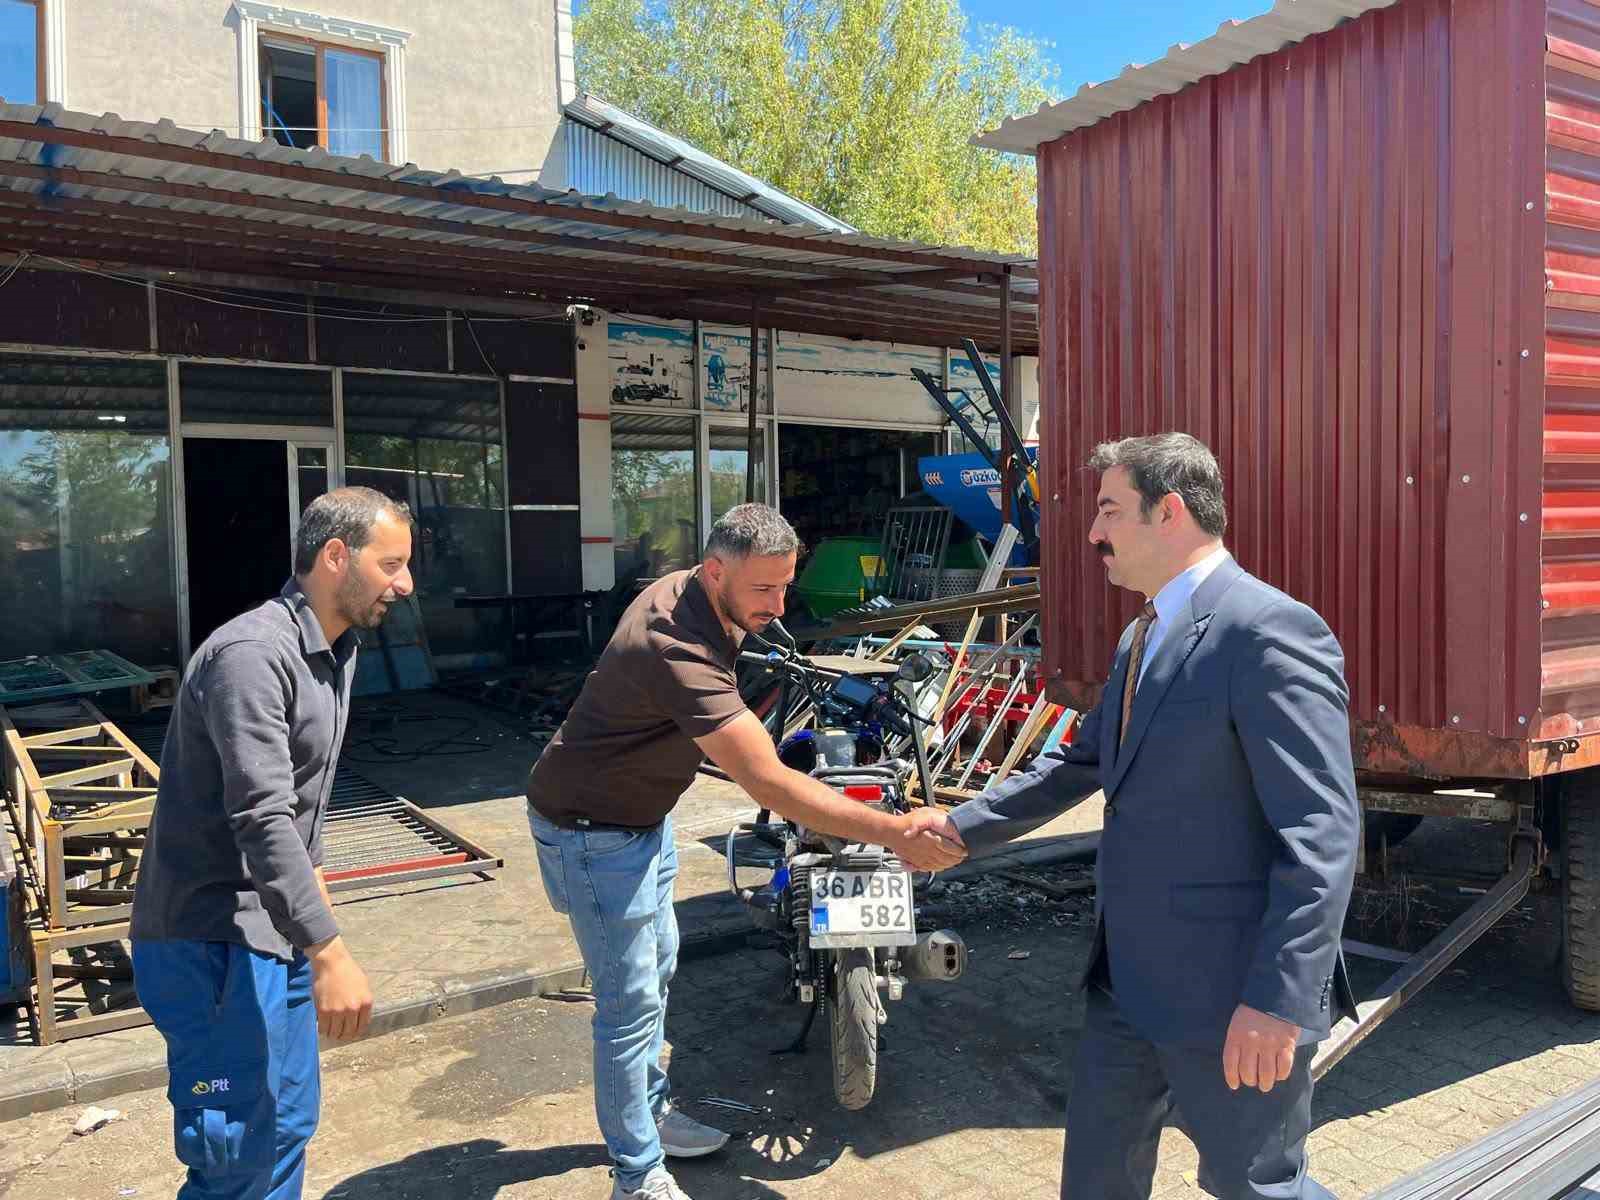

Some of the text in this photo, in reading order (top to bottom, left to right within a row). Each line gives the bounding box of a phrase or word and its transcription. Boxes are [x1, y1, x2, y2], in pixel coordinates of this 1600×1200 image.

[815, 875, 905, 899] 36 ABR
[860, 904, 906, 928] 582
[211, 1078, 230, 1093] Ptt
